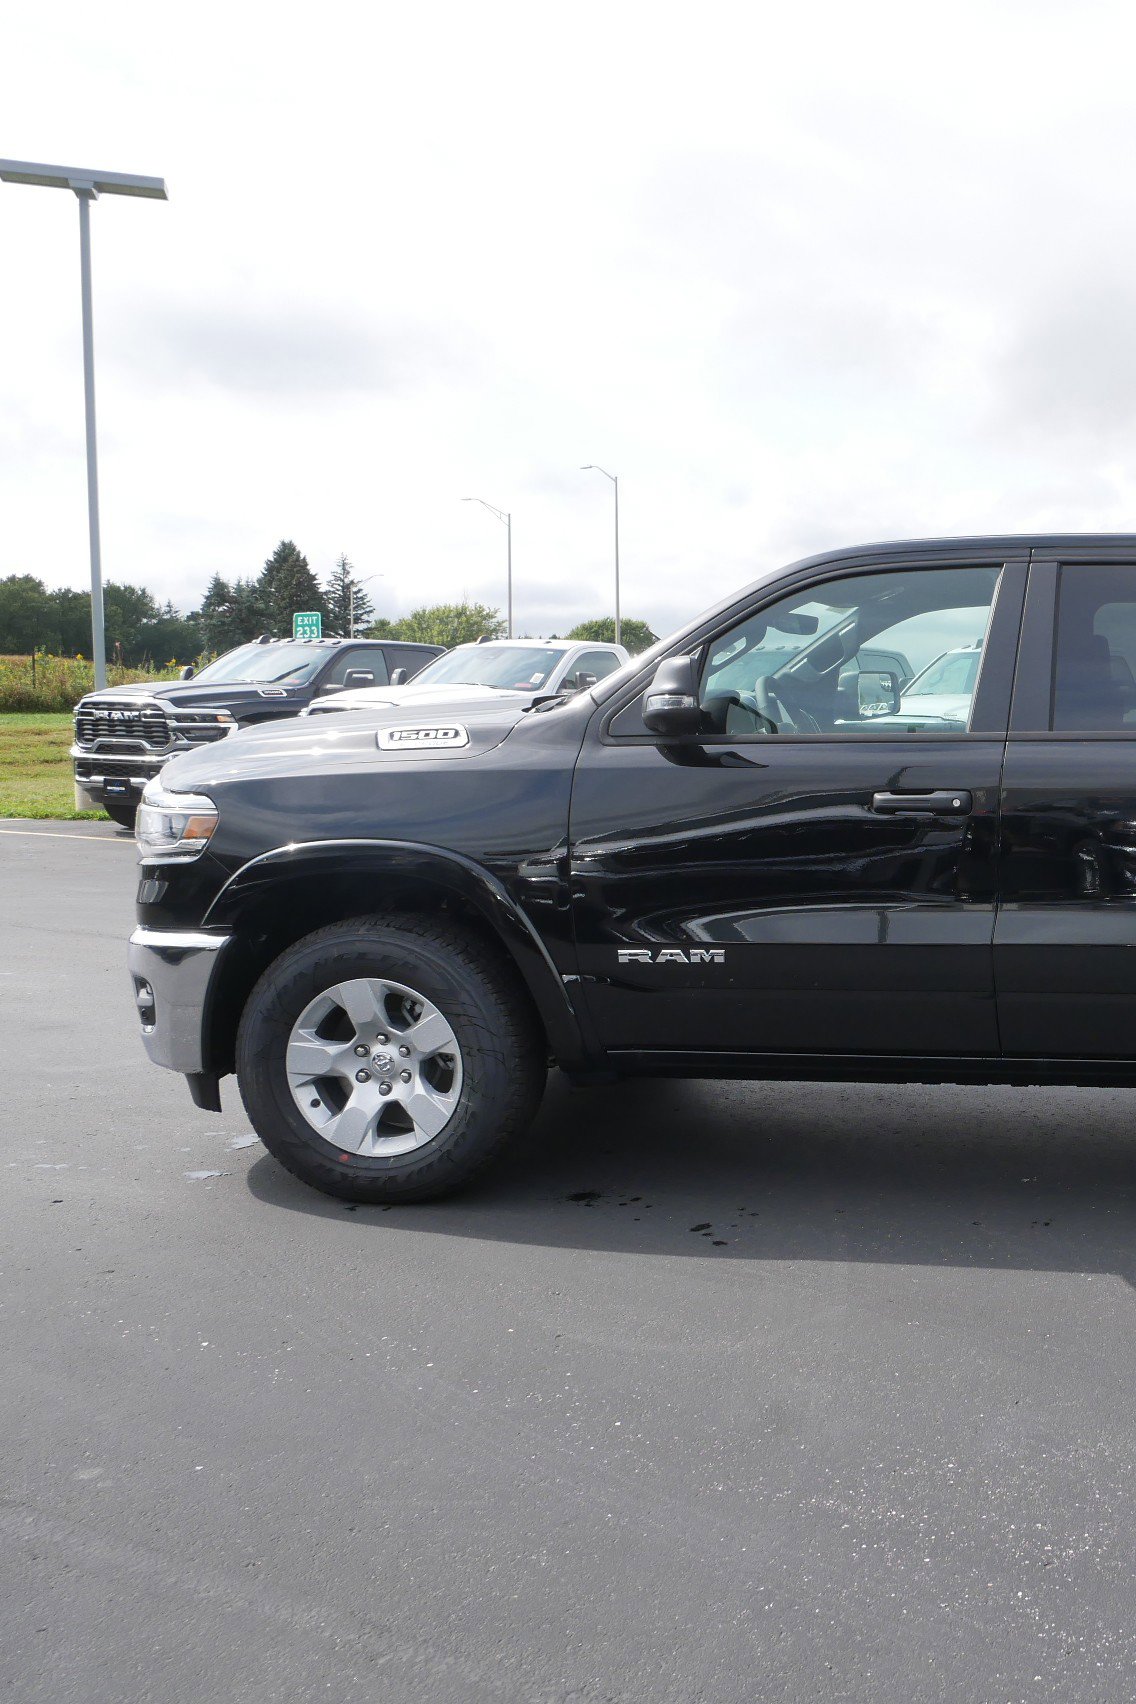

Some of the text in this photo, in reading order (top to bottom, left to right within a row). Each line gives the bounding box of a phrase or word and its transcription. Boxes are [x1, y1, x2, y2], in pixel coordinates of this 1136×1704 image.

[297, 616, 317, 625] EXIT
[296, 626, 318, 638] 233
[94, 710, 140, 720] RAM
[390, 728, 459, 741] 1500
[617, 949, 725, 963] RAM
